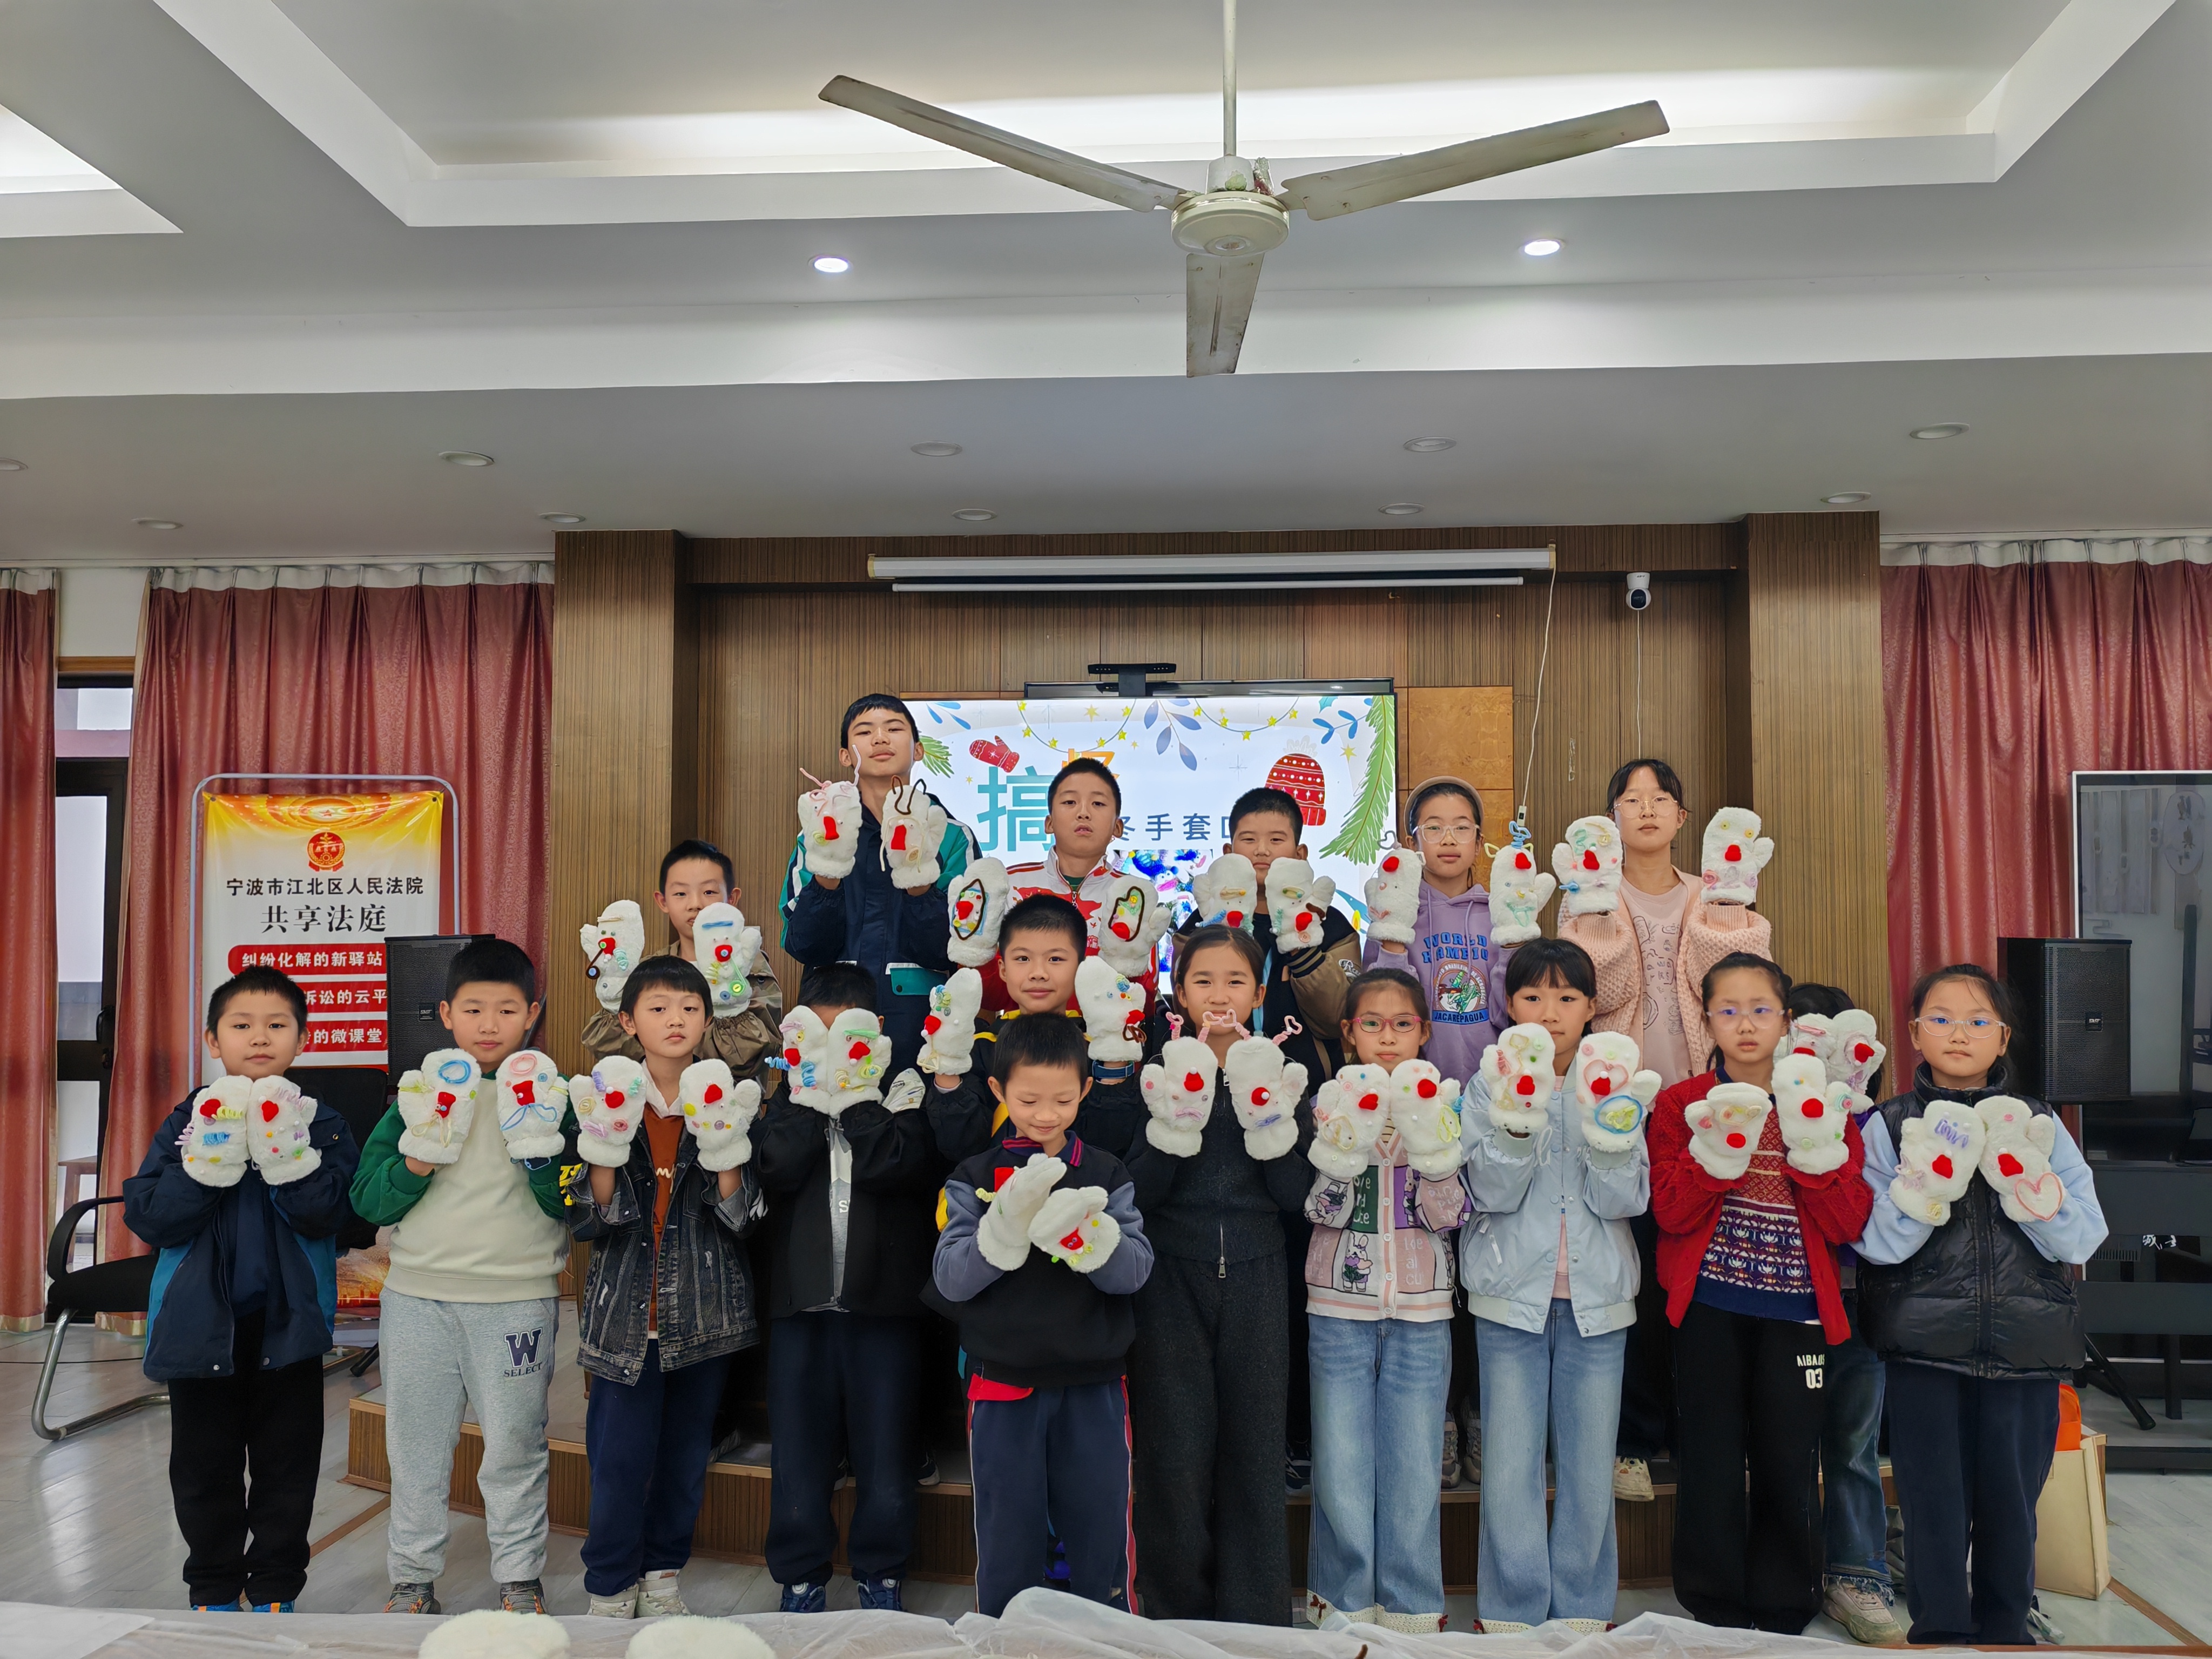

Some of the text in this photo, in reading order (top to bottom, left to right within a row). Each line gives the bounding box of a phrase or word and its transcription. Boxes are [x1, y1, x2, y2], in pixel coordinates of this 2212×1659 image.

[226, 876, 424, 896] 宁波市江北区人民法院
[260, 903, 386, 933] 共享法庭
[241, 951, 383, 968] 纠纷化解的新驿站
[1434, 1011, 1485, 1023] JACAREPAGUA
[306, 1028, 382, 1044] 的微课堂
[504, 1327, 543, 1368] W
[504, 1361, 543, 1378] SELECT
[1805, 1367, 1823, 1388] 03
